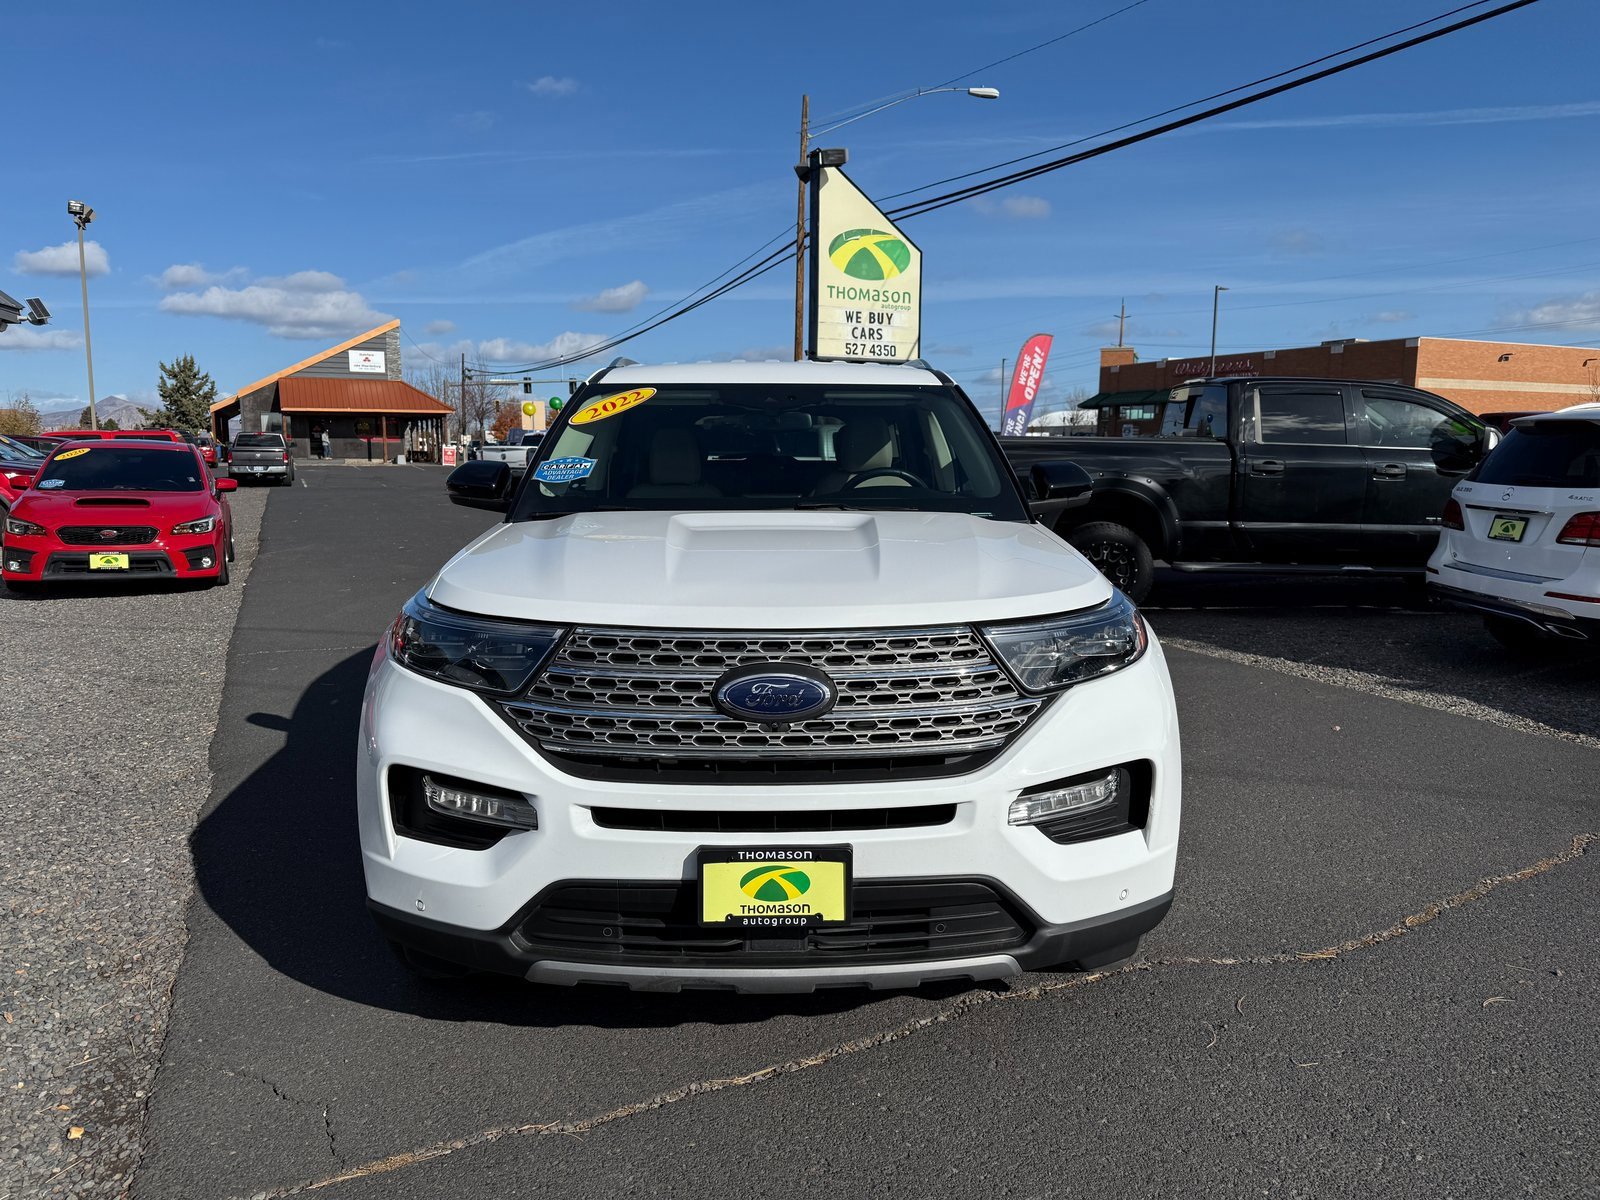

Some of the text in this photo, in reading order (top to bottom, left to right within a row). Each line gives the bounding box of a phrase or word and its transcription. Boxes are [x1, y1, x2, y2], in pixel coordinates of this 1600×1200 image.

[827, 285, 911, 303] THOMason
[881, 303, 912, 311] autogroup
[845, 310, 894, 325] WE BUY
[851, 326, 883, 341] CARS
[1018, 354, 1032, 385] WE'RE
[1024, 346, 1045, 400] OPEN!
[585, 391, 645, 420] 2022
[61, 449, 86, 459] 2020
[541, 462, 591, 470] CARFAX
[744, 682, 805, 708] Ford
[742, 917, 807, 927] autogroup
